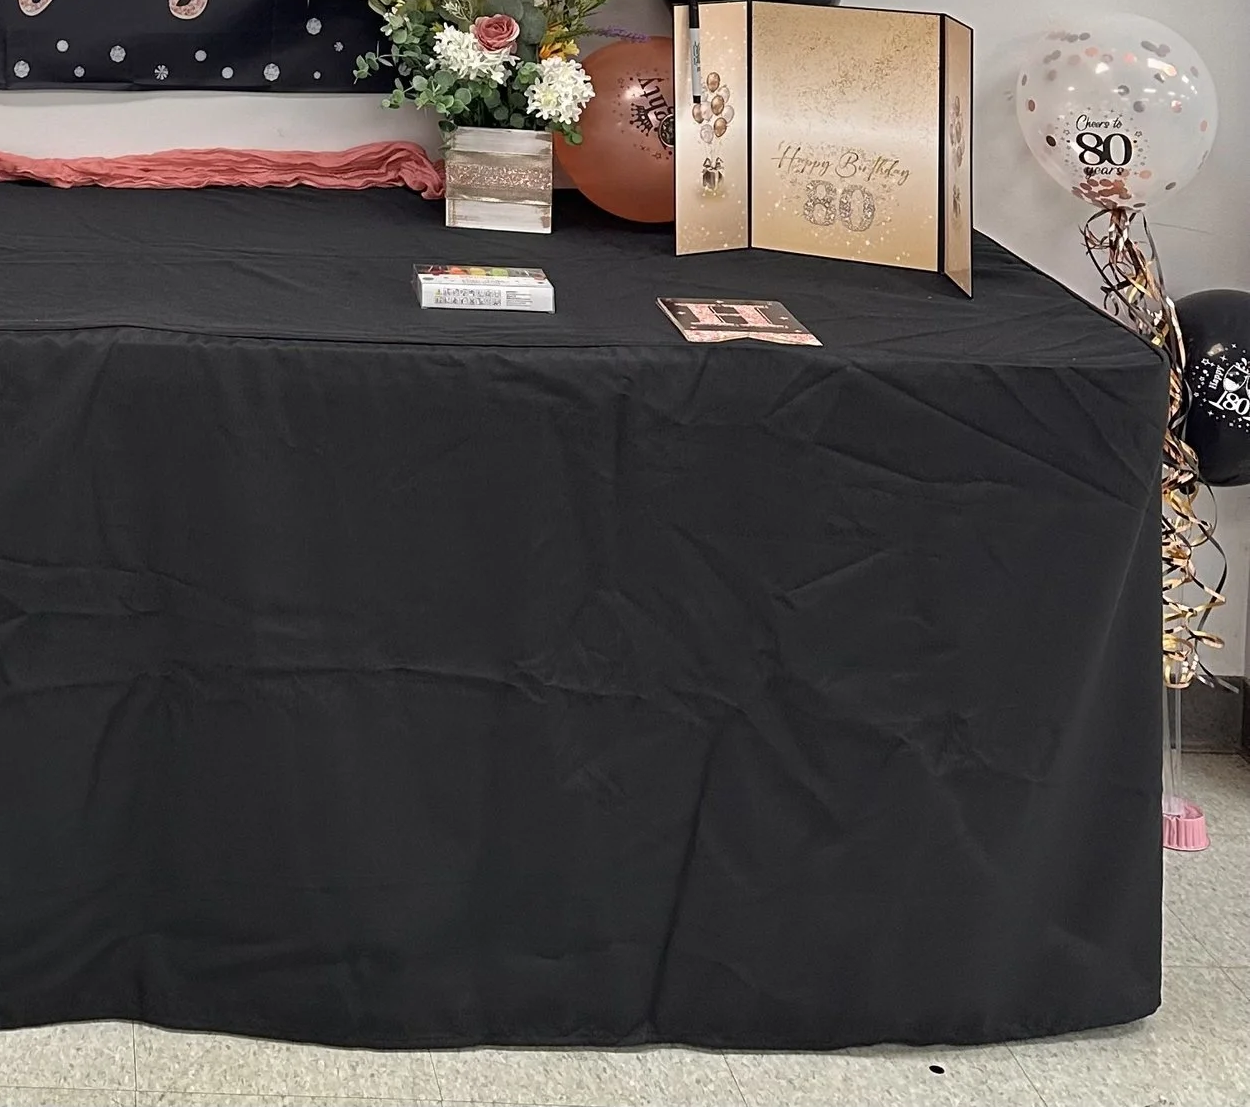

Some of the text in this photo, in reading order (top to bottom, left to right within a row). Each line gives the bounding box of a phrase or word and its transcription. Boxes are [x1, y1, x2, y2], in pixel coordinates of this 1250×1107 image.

[1075, 114, 1123, 132] Cheers to
[1075, 132, 1132, 166] 80
[771, 141, 911, 186] Happy Birthday
[1083, 166, 1125, 180] years
[803, 180, 876, 232] 80
[1208, 364, 1225, 390] Happy
[1222, 392, 1250, 416] 80
